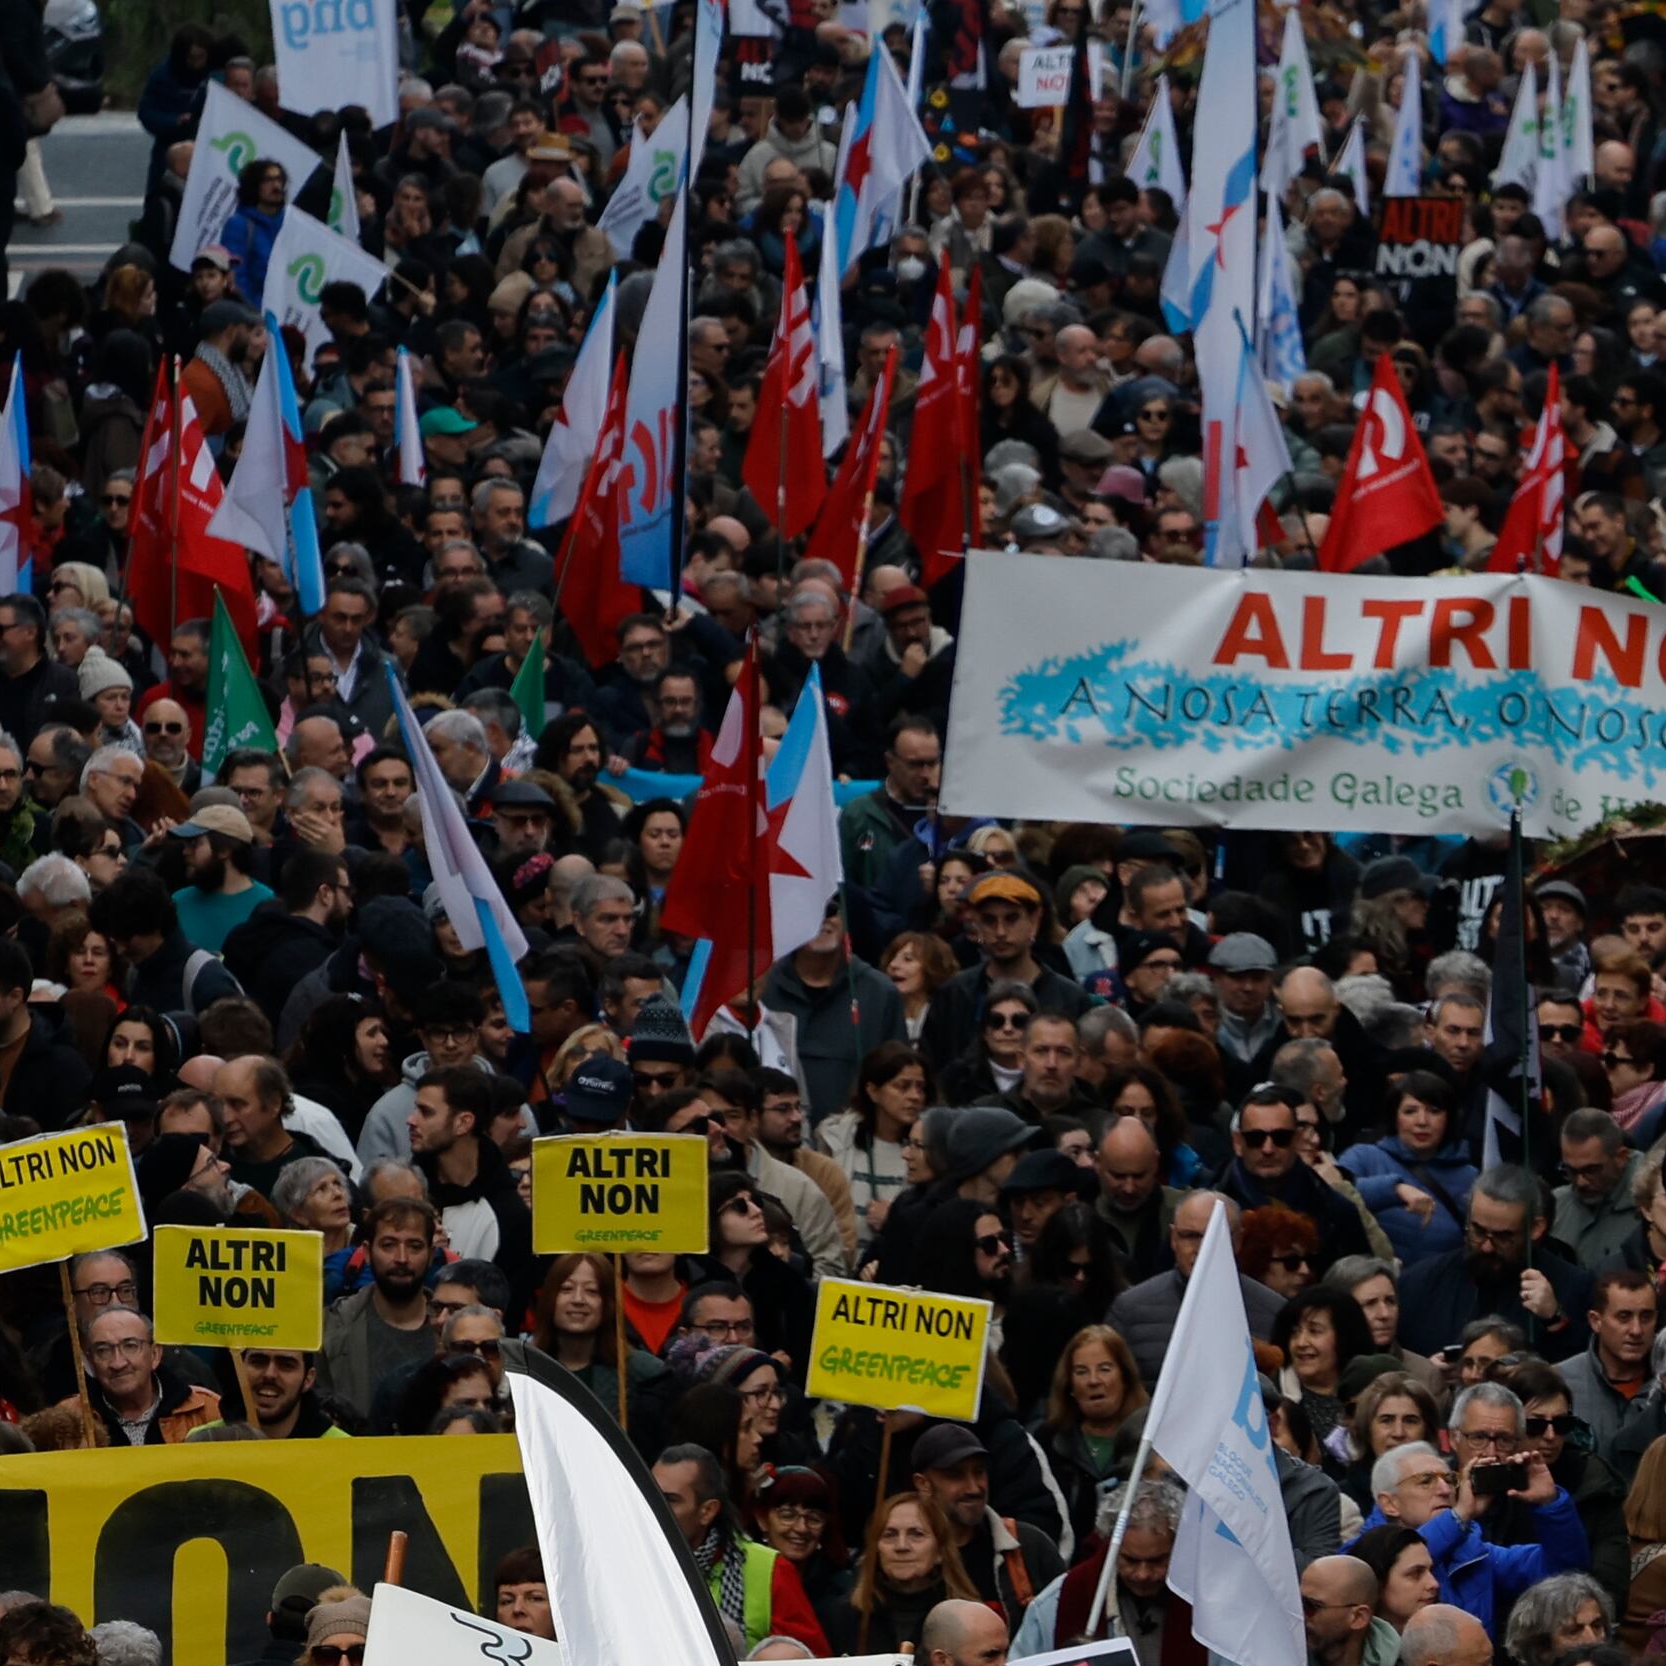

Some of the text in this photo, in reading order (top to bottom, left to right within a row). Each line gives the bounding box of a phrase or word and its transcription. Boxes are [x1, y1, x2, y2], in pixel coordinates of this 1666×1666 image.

[1378, 199, 1462, 243] ALTRI
[1375, 237, 1460, 277] NON
[1212, 592, 1530, 672] ALTRI
[1060, 676, 1101, 715] A
[1125, 680, 1278, 727] NOSA
[1299, 683, 1470, 732] TERRA,
[1499, 692, 1530, 727] O
[1112, 765, 1316, 804] Sociedade
[1330, 772, 1463, 816] Galega
[1551, 788, 1582, 821] de
[61, 1135, 117, 1176] NON
[567, 1147, 671, 1178] ALTRI
[580, 1183, 659, 1215] NON
[574, 1227, 663, 1244] GREENPEACE
[185, 1239, 287, 1273] ALTRI
[199, 1275, 276, 1309] NON
[194, 1321, 279, 1338] GREENPEACE
[832, 1294, 973, 1341] ALTRI NON
[818, 1345, 972, 1390] GREENPEACE
